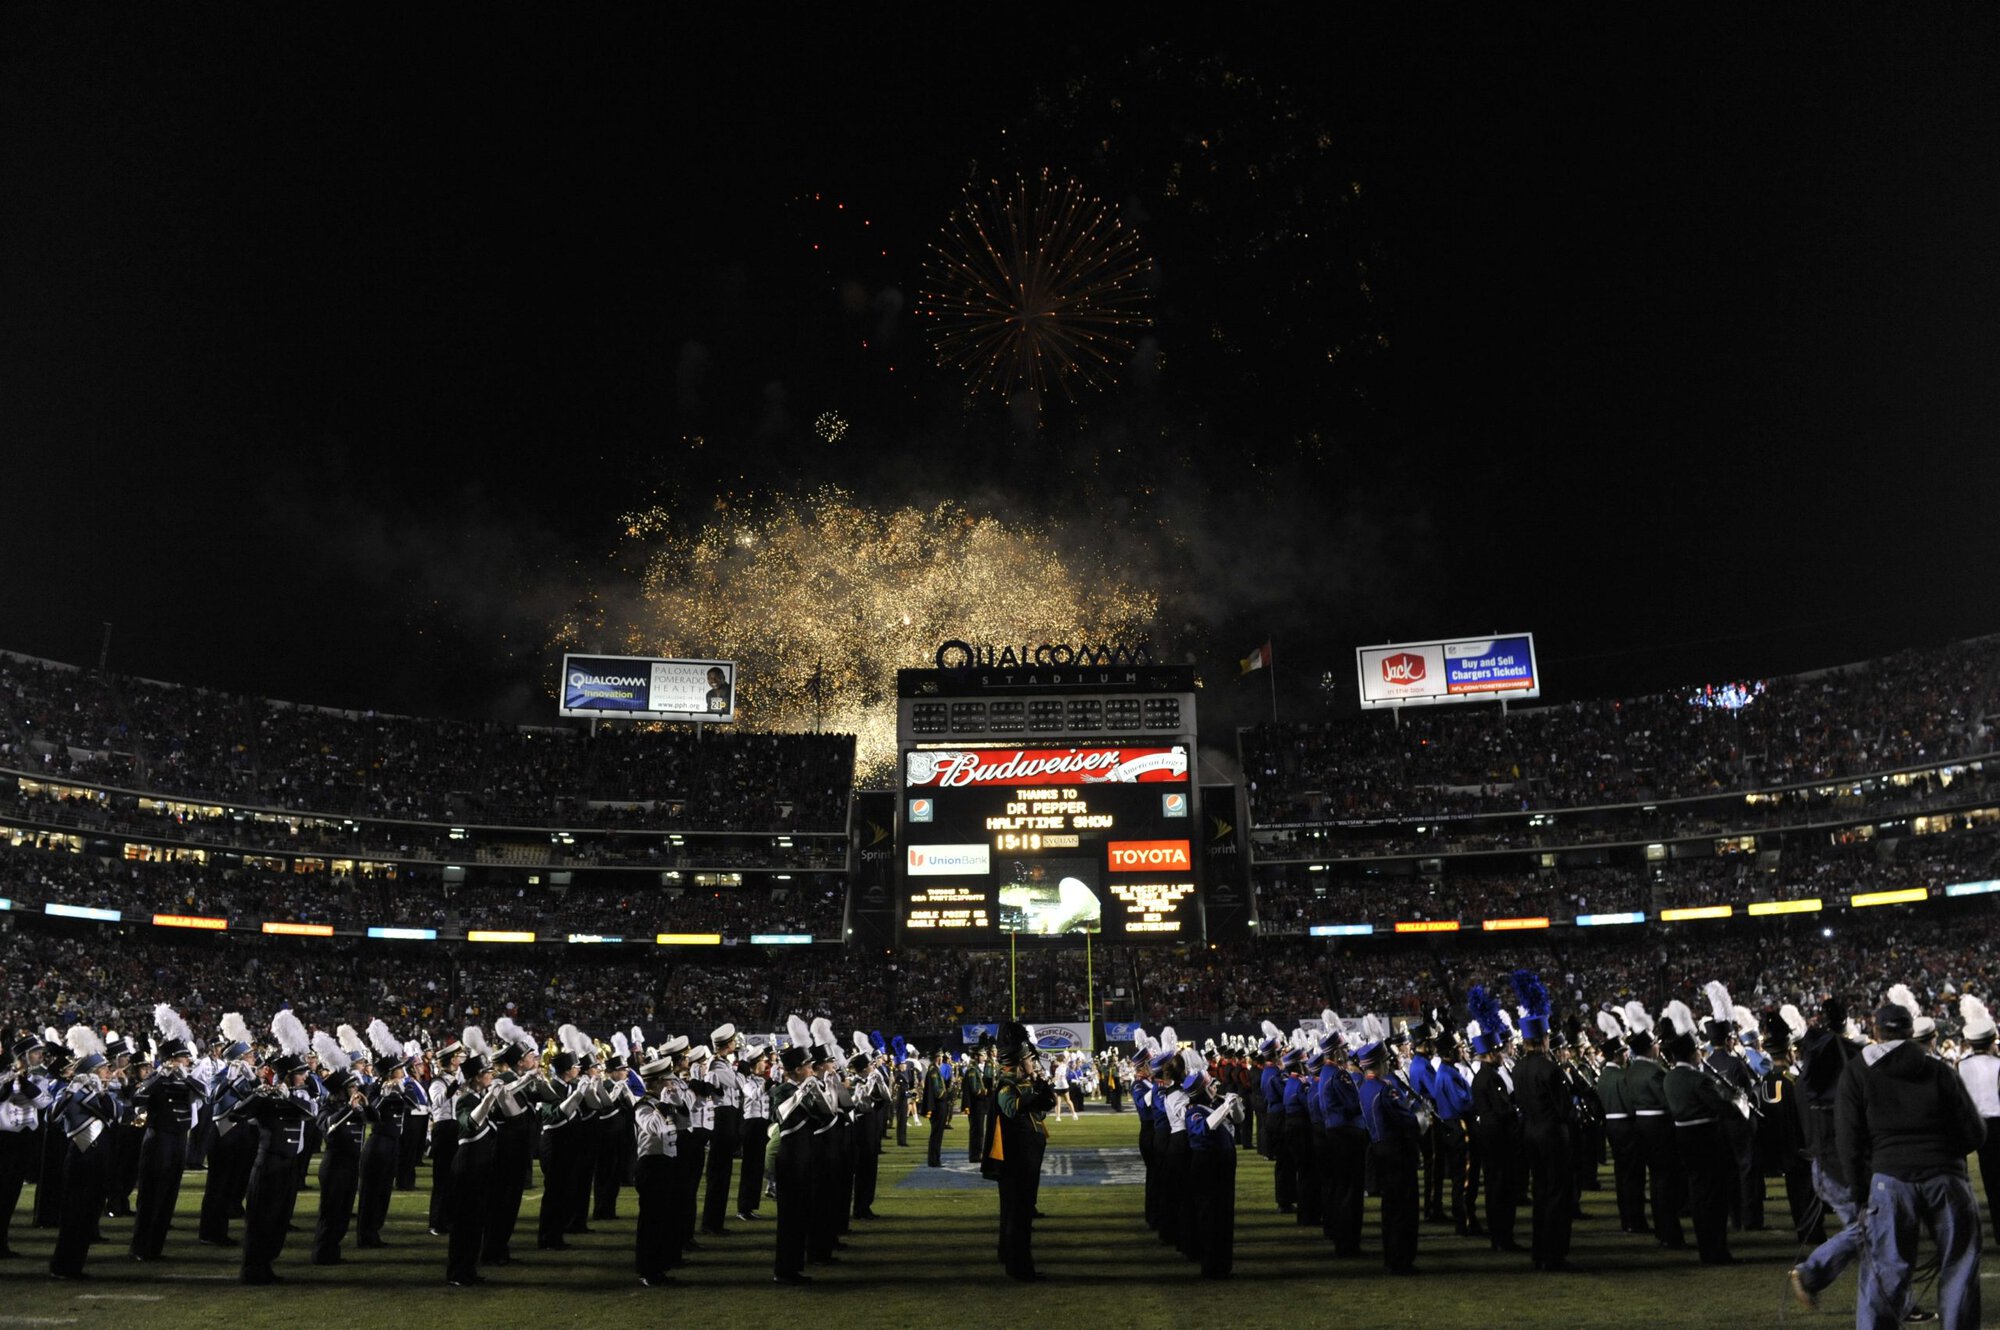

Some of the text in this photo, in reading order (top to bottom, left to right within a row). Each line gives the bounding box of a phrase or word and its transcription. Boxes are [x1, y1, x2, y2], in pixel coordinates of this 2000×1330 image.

[936, 640, 1153, 669] QUALCOMM
[1384, 656, 1424, 681] Jack
[1462, 656, 1514, 669] Buy and Sell
[655, 667, 706, 676] PALOMAR
[1452, 665, 1527, 681] Chargers Tickets!
[571, 672, 646, 689] QUALCOMM
[655, 676, 706, 685] POMERADO
[981, 673, 1137, 685] STADIUM
[654, 684, 705, 693] HEALTH
[658, 702, 700, 710] www.pph.org
[712, 701, 721, 709] 21
[932, 749, 1121, 787] Budweiser
[1123, 758, 1184, 776] American Lager
[1016, 788, 1077, 800] THANKS TO
[1007, 801, 1087, 815] DR PEPPER
[986, 815, 1113, 830] HALFTIME SHOW
[1205, 840, 1237, 855] Sprint
[861, 849, 891, 862] Sprint
[929, 855, 987, 865] UnionBank
[1112, 848, 1186, 864] TOYOTA
[1110, 884, 1194, 894] THE PACIFIC LIFE
[943, 910, 970, 919] POINT
[157, 916, 226, 929] WELLS FARGO
[1397, 922, 1458, 931] WELLS FARGO
[1035, 1028, 1074, 1040] PACIFIC LIFE
[1762, 1080, 1783, 1104] U
